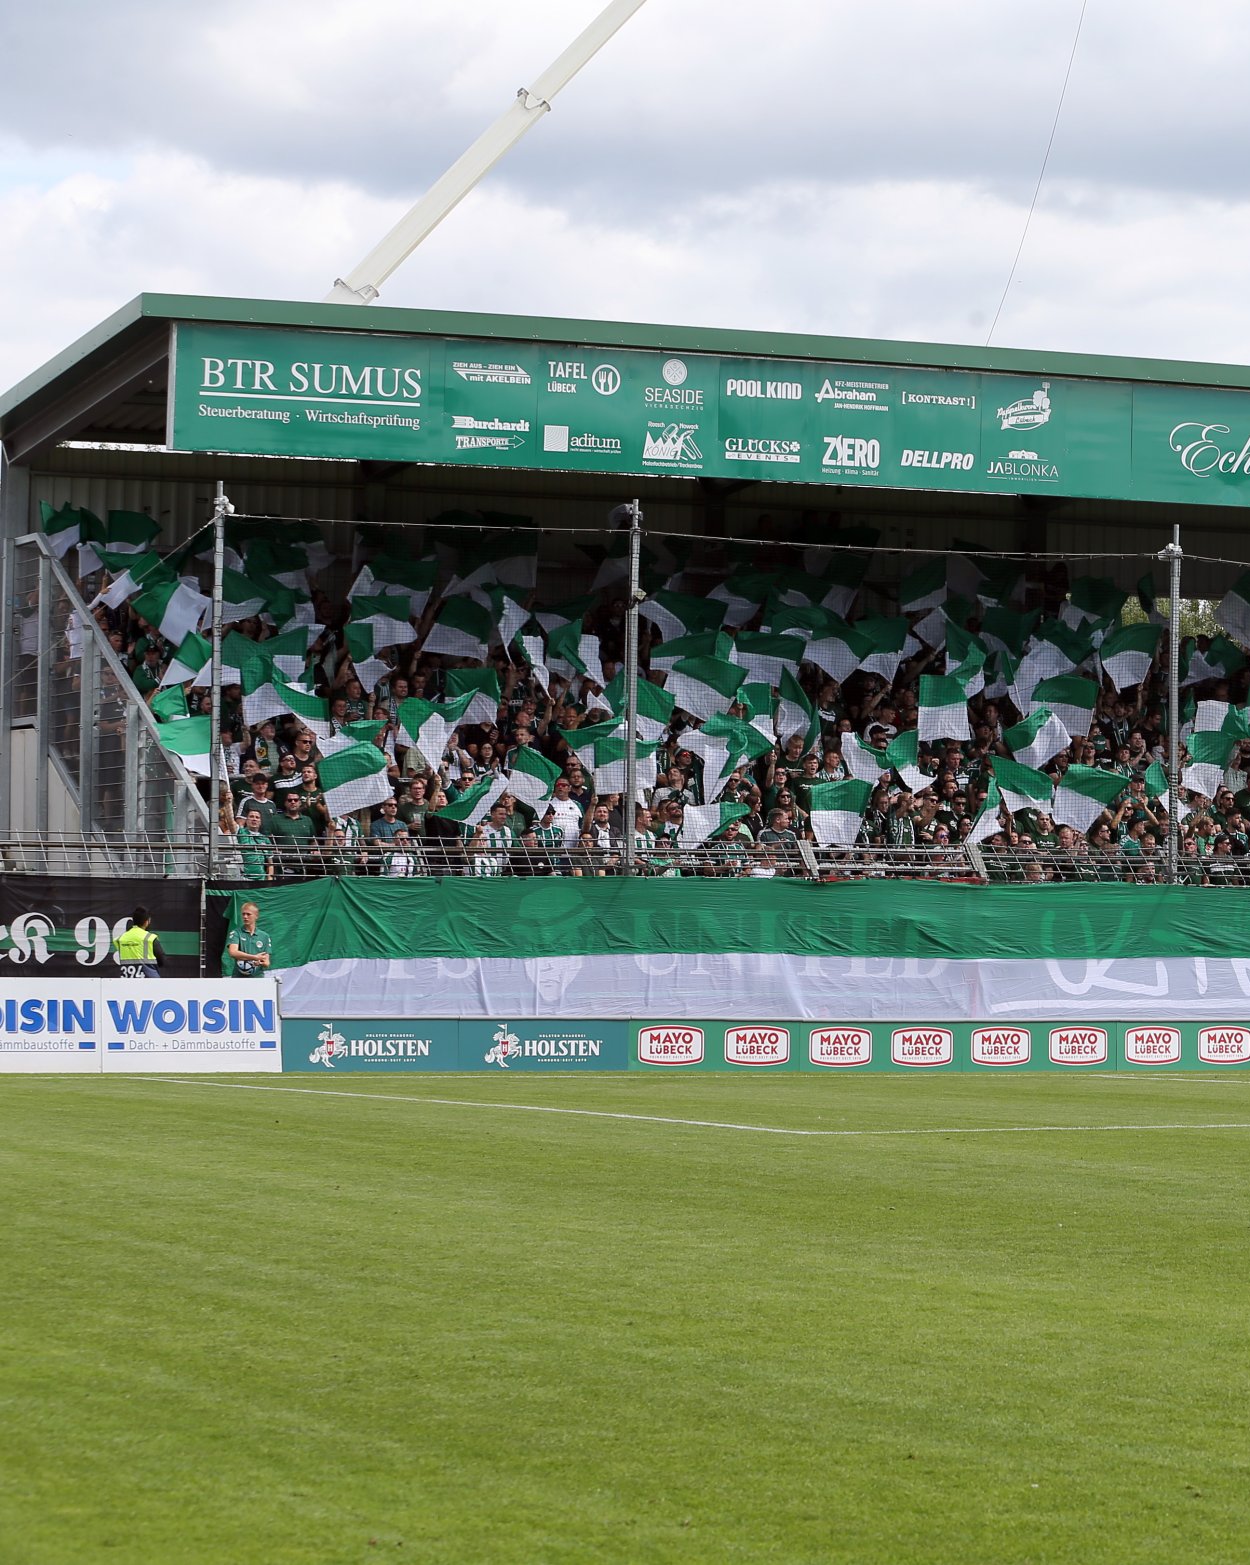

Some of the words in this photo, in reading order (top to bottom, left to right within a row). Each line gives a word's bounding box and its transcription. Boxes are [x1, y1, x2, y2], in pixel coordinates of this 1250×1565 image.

[548, 361, 588, 379] TAFEL
[201, 357, 278, 391] BTR
[289, 361, 422, 399] SUMUS
[485, 375, 532, 385] AKELBEIN
[547, 382, 577, 394] LÜBECK
[815, 378, 877, 402] Abraham
[644, 387, 704, 405] SEASIDE
[198, 403, 290, 423] Steuerberatung
[305, 409, 421, 430] Wirtschaftsprüfung
[452, 415, 530, 432] Burchardt
[570, 433, 621, 448] aditum
[737, 452, 789, 462] EVENTS
[901, 449, 974, 470] DELLPRO
[986, 461, 1060, 478] JABLONKA
[0, 999, 96, 1034] ISIN
[107, 999, 276, 1034] WOISIN
[129, 1039, 159, 1050] Dach-
[172, 1038, 256, 1050] Dämmbaustoffe
[649, 1032, 693, 1044] MAYO
[736, 1033, 779, 1044] MAYO
[820, 1034, 862, 1045] MAYO
[902, 1034, 943, 1045] MAYO
[981, 1033, 1021, 1045] MAYO
[1059, 1033, 1098, 1045] MAYO
[1135, 1033, 1172, 1044] MAYO
[1207, 1033, 1244, 1044] MAYO
[350, 1039, 430, 1056] HOLSTEN
[524, 1040, 600, 1056] HOLSTEN
[649, 1045, 692, 1055] LÜBECK
[736, 1045, 777, 1055] LÜBECK
[820, 1047, 860, 1056] LÜBECK
[902, 1047, 942, 1056] LÜBECK
[981, 1046, 1020, 1055] LÜBECK
[1059, 1046, 1096, 1055] LÜBECK
[1135, 1045, 1171, 1054] LÜBECK
[1207, 1045, 1243, 1054] LÜBECK
